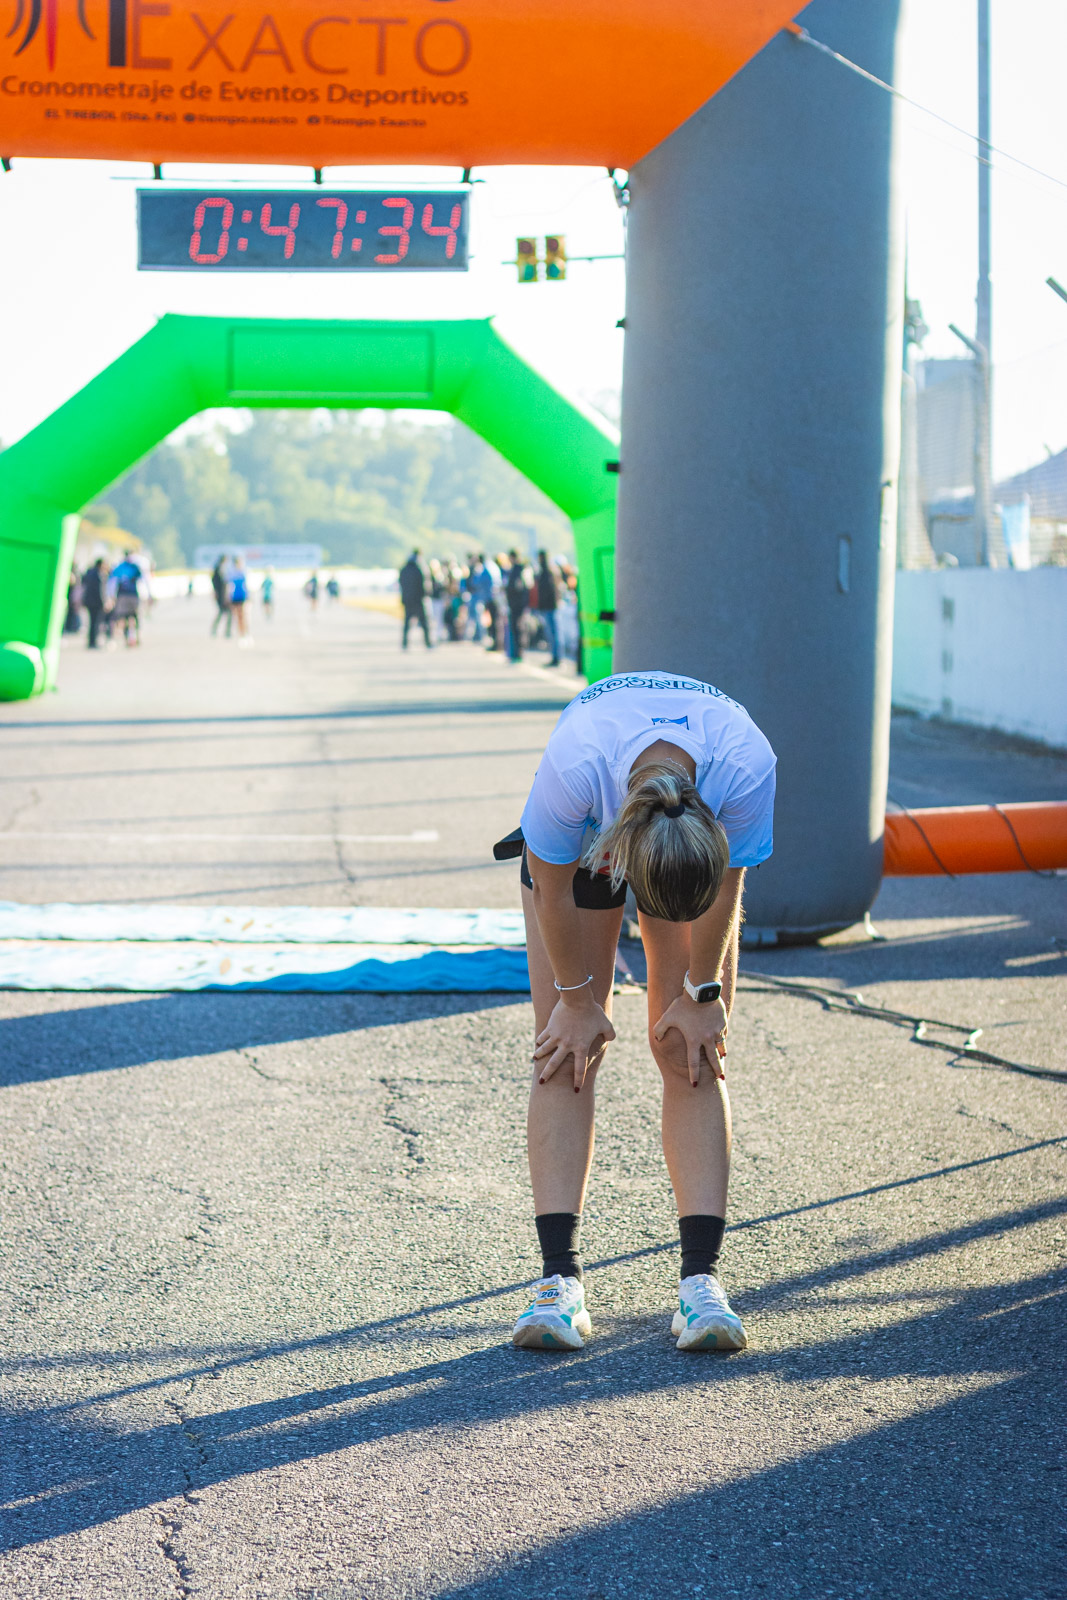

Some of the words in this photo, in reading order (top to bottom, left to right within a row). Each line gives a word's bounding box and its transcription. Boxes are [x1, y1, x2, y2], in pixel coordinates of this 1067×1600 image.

[132, 1, 471, 76] EXACTO
[1, 75, 174, 102] Cronometraje
[180, 80, 212, 100] de
[219, 81, 319, 103] Eventos
[327, 83, 469, 107] Deportivos
